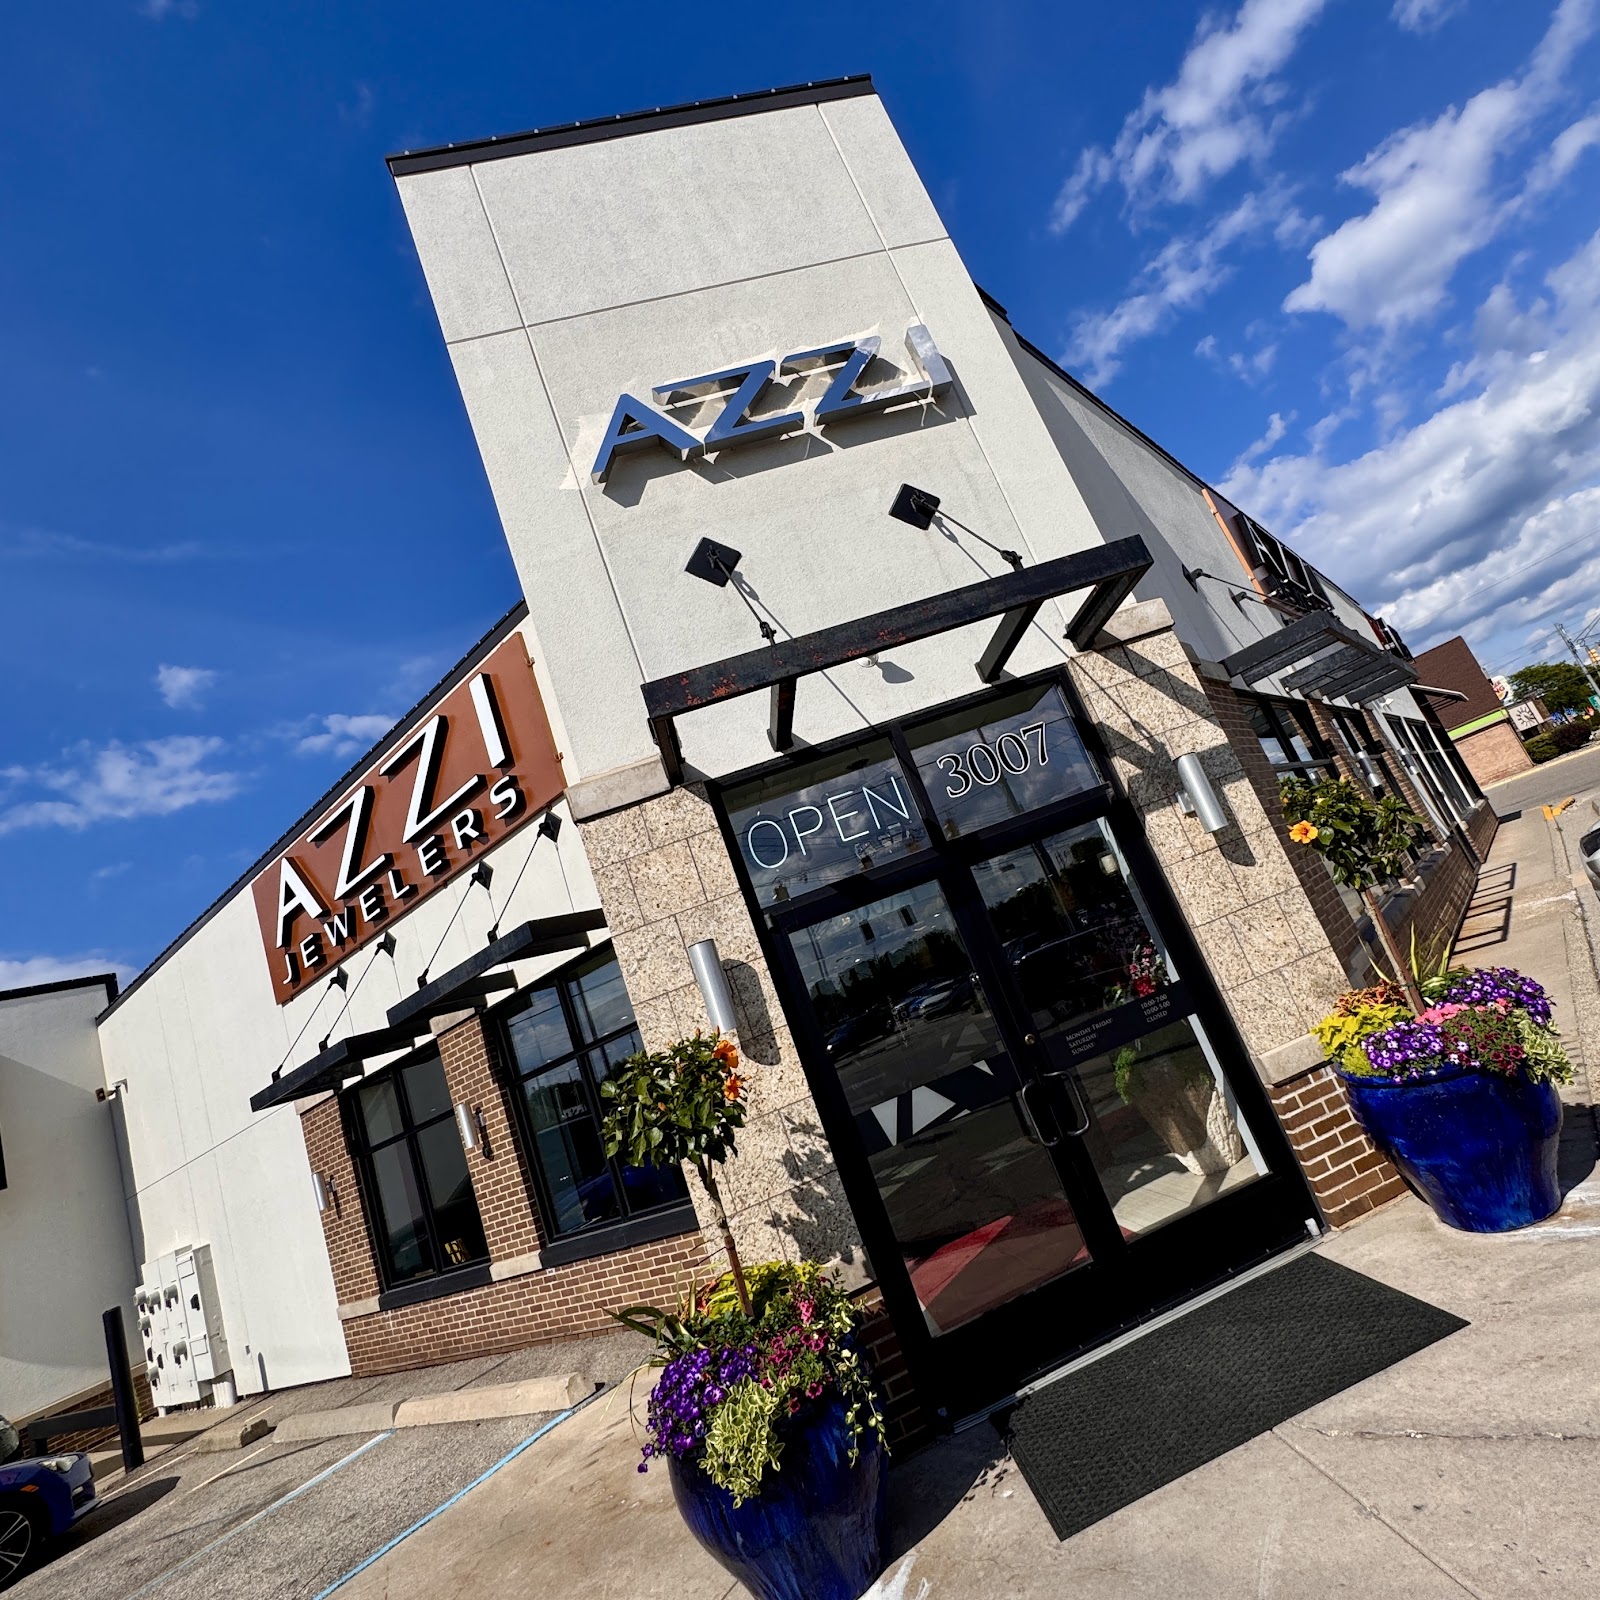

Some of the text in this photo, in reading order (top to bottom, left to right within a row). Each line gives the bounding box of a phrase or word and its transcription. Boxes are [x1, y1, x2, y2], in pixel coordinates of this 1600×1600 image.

[591, 323, 953, 485] AZZI
[275, 672, 512, 949] AZZI
[747, 776, 910, 869] OPEN
[936, 721, 1050, 799] 3007
[282, 775, 521, 986] JEWELERS
